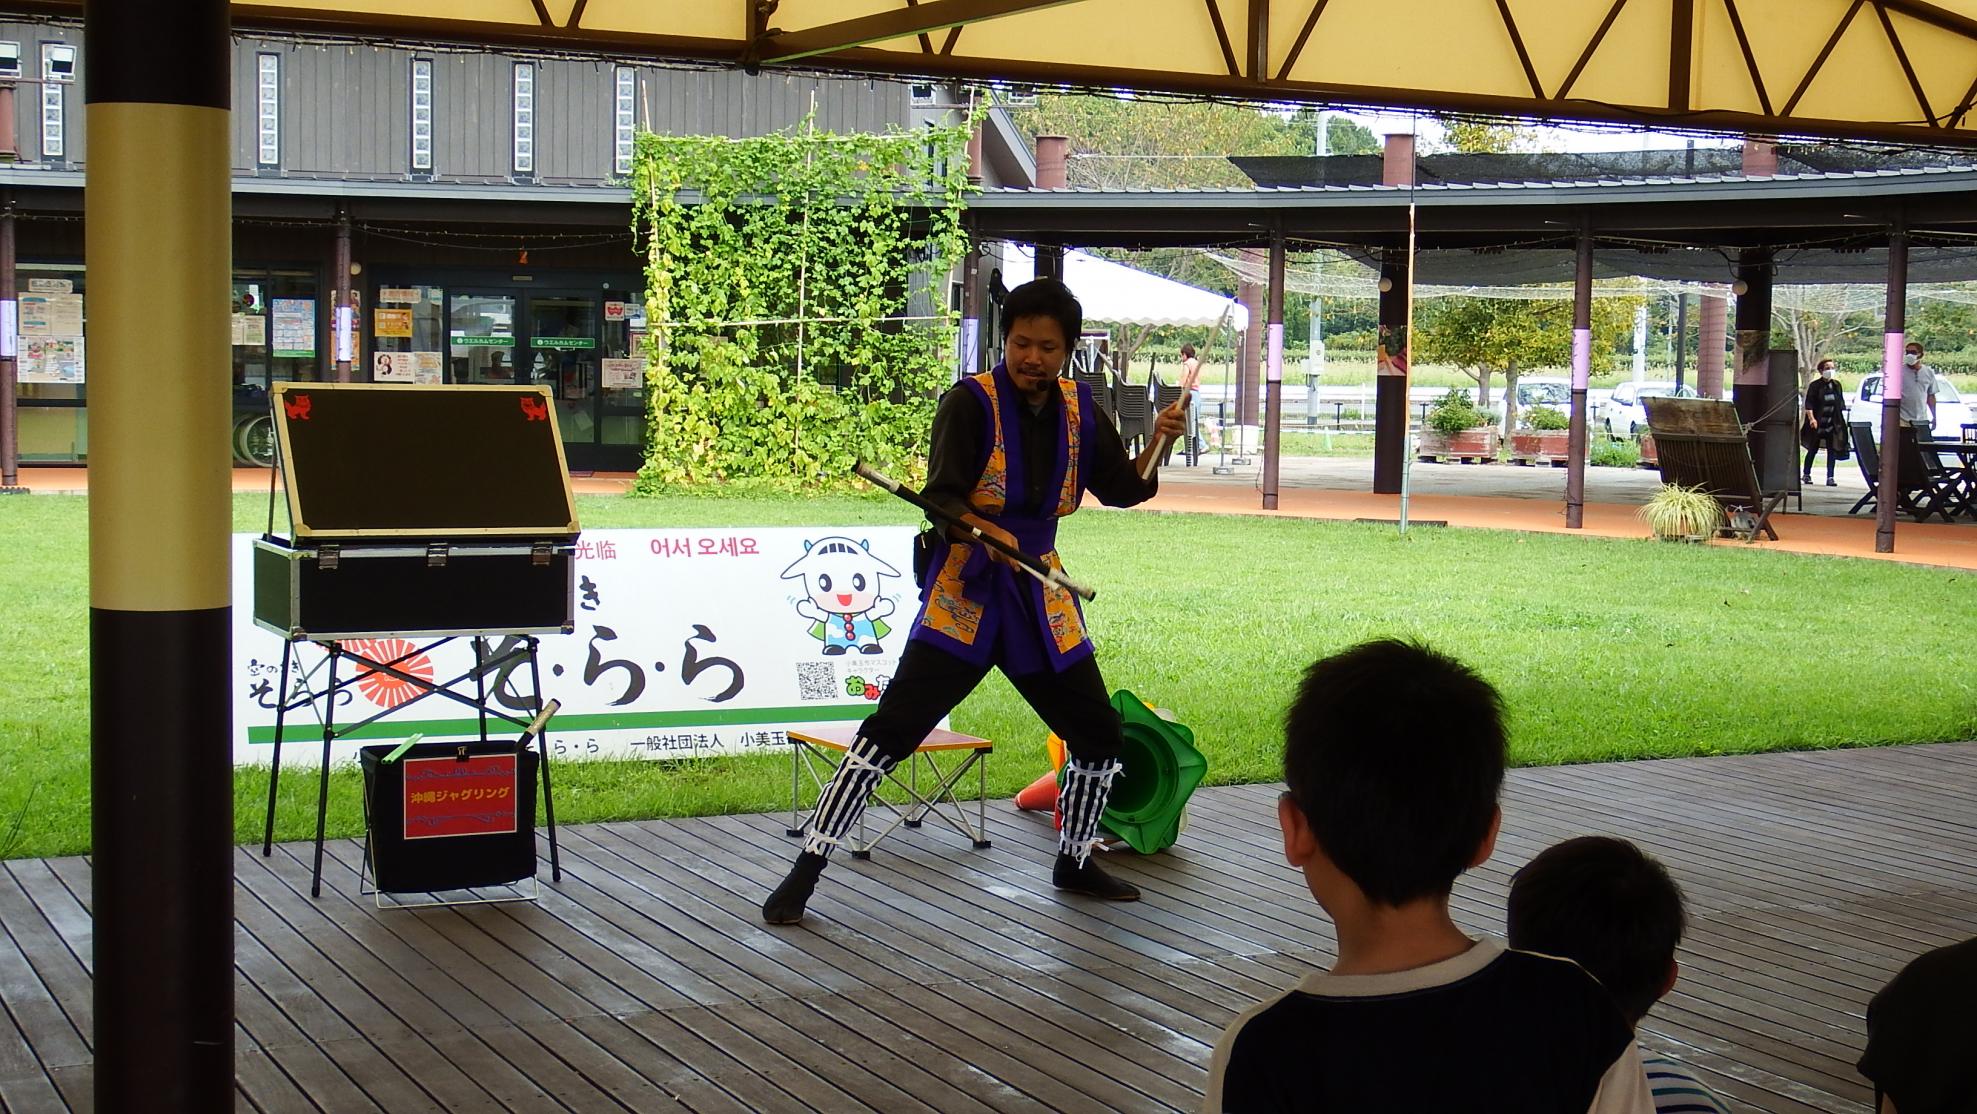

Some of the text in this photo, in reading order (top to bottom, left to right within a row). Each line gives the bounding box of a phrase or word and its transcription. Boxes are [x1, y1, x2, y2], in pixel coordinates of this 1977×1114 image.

[575, 539, 617, 560] 光临
[650, 536, 760, 558] 어서 오세요
[248, 658, 300, 676] 空のき
[630, 733, 725, 751] 一般社団法人
[410, 786, 511, 804] 沖縄ジャグリング
